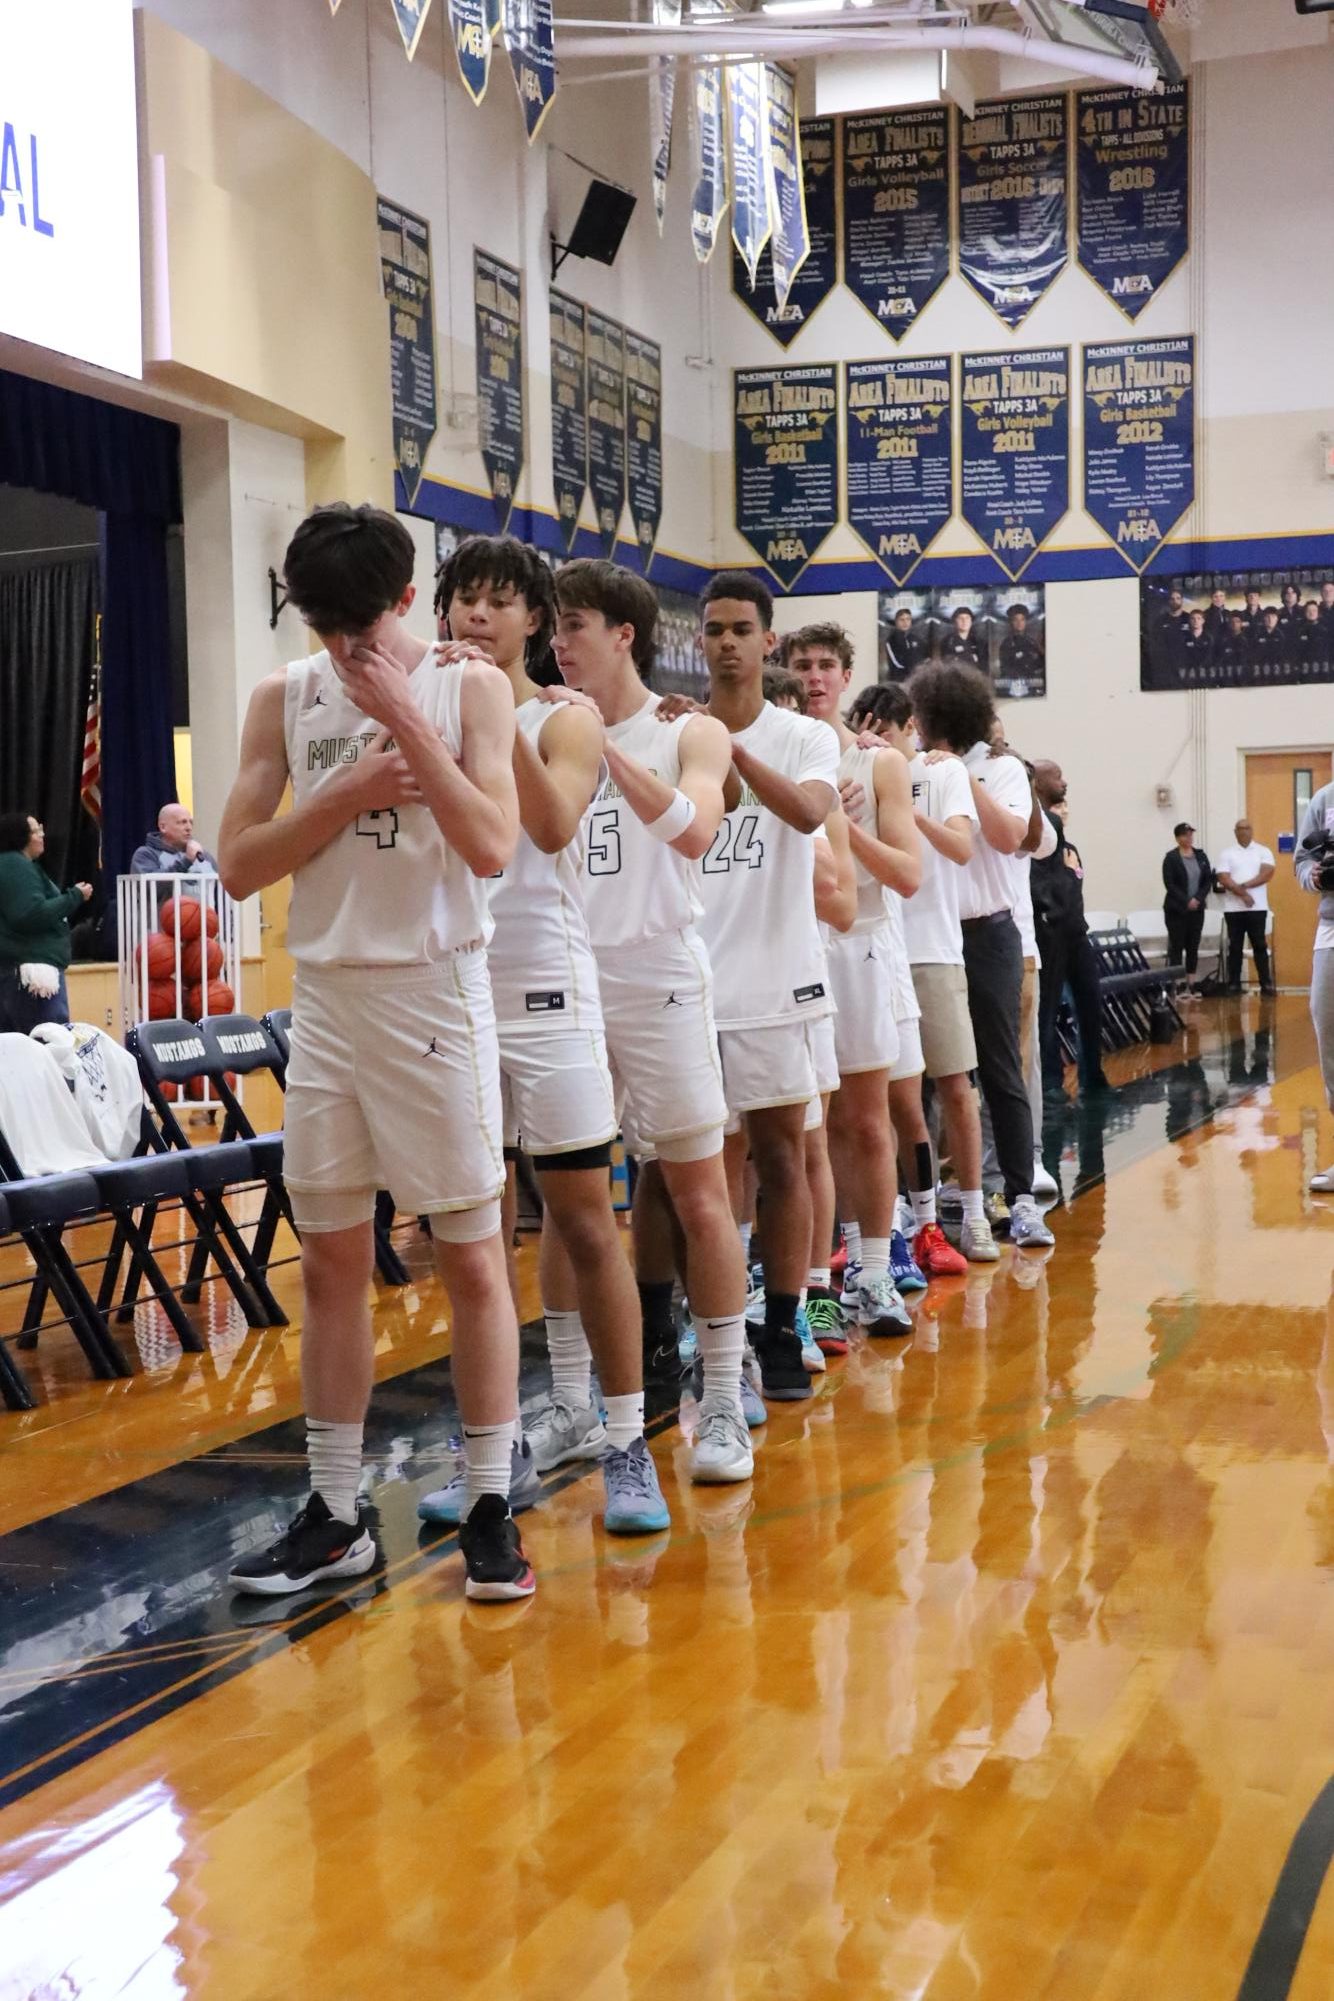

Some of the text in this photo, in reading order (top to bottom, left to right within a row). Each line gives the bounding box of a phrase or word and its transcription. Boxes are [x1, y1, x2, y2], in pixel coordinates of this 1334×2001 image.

[1081, 84, 1184, 104] McKINNEY CHRITIAN
[1011, 99, 1062, 112] CHRISTIAN
[847, 111, 944, 129] McKINNEY CHRISTIAN
[990, 143, 1035, 159] TAPPS 3A
[1096, 145, 1168, 163] Wrestling
[874, 153, 918, 170] TAPPS 3A
[977, 161, 1050, 177] Girls Soccer
[847, 168, 944, 187] Girls Volleyball
[874, 187, 919, 212] 2015
[1112, 275, 1154, 294] MCA
[1087, 341, 1189, 359] McKINNEY CHRISTIAN
[849, 360, 947, 376] McKINNEY CHRISTIAN
[965, 351, 1064, 368] McKINNEY CHRISTIAN
[738, 367, 832, 383] McKINNEY CHRISTIAN
[993, 398, 1038, 414] TAPPS 3A
[1116, 389, 1162, 405] TAPPS 3A
[765, 412, 808, 428] TAPPS 3A
[878, 407, 922, 422] TAPPS 3A
[977, 412, 1053, 431] Girls Volleyball
[1100, 403, 1176, 423] Girls Basketball
[897, 423, 938, 436] Football
[1117, 420, 1163, 444] 2012
[877, 436, 919, 459] 2011
[993, 430, 1035, 453] 2011
[765, 443, 806, 465] 2011
[1178, 665, 1242, 679] VARSITY
[356, 808, 398, 850] 4
[588, 810, 621, 876] 5
[703, 816, 763, 874] 24
[153, 1037, 206, 1063] MUSTANGS
[216, 1031, 267, 1054] MUSTANGS
